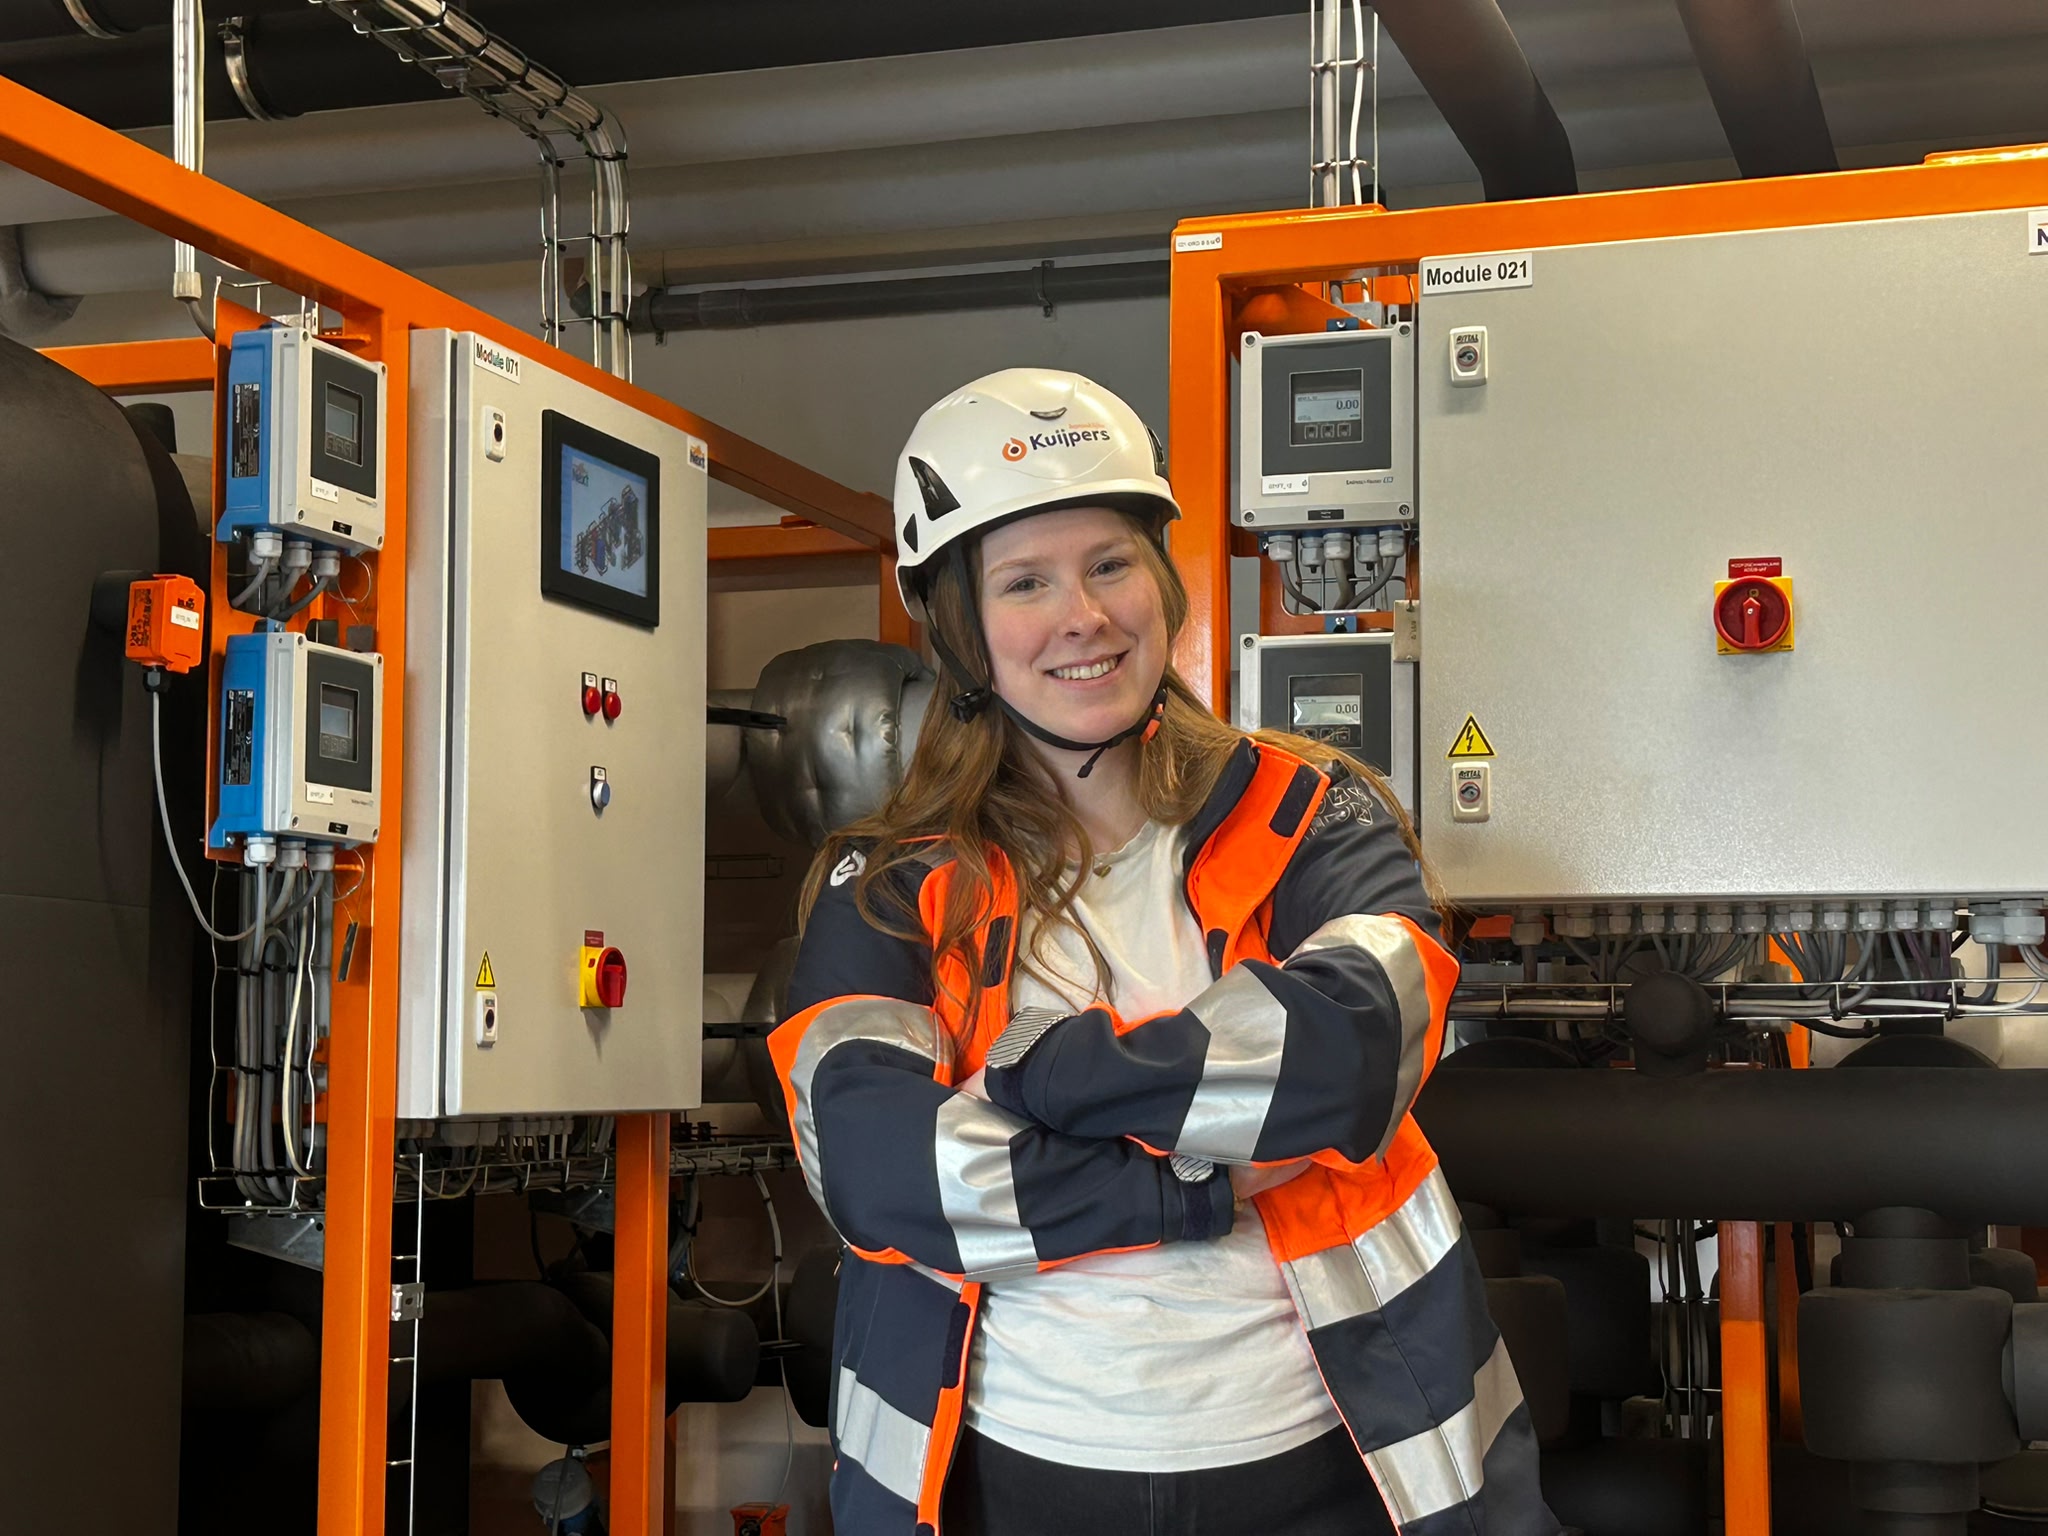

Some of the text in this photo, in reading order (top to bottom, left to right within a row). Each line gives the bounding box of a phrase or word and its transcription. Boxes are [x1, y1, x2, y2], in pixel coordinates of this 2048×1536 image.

[1426, 260, 1527, 286] Module 021
[476, 343, 519, 377] Module 071
[1336, 399, 1360, 410] 0.00
[1029, 428, 1111, 451] Kuijpers
[1335, 703, 1359, 714] 0.00
